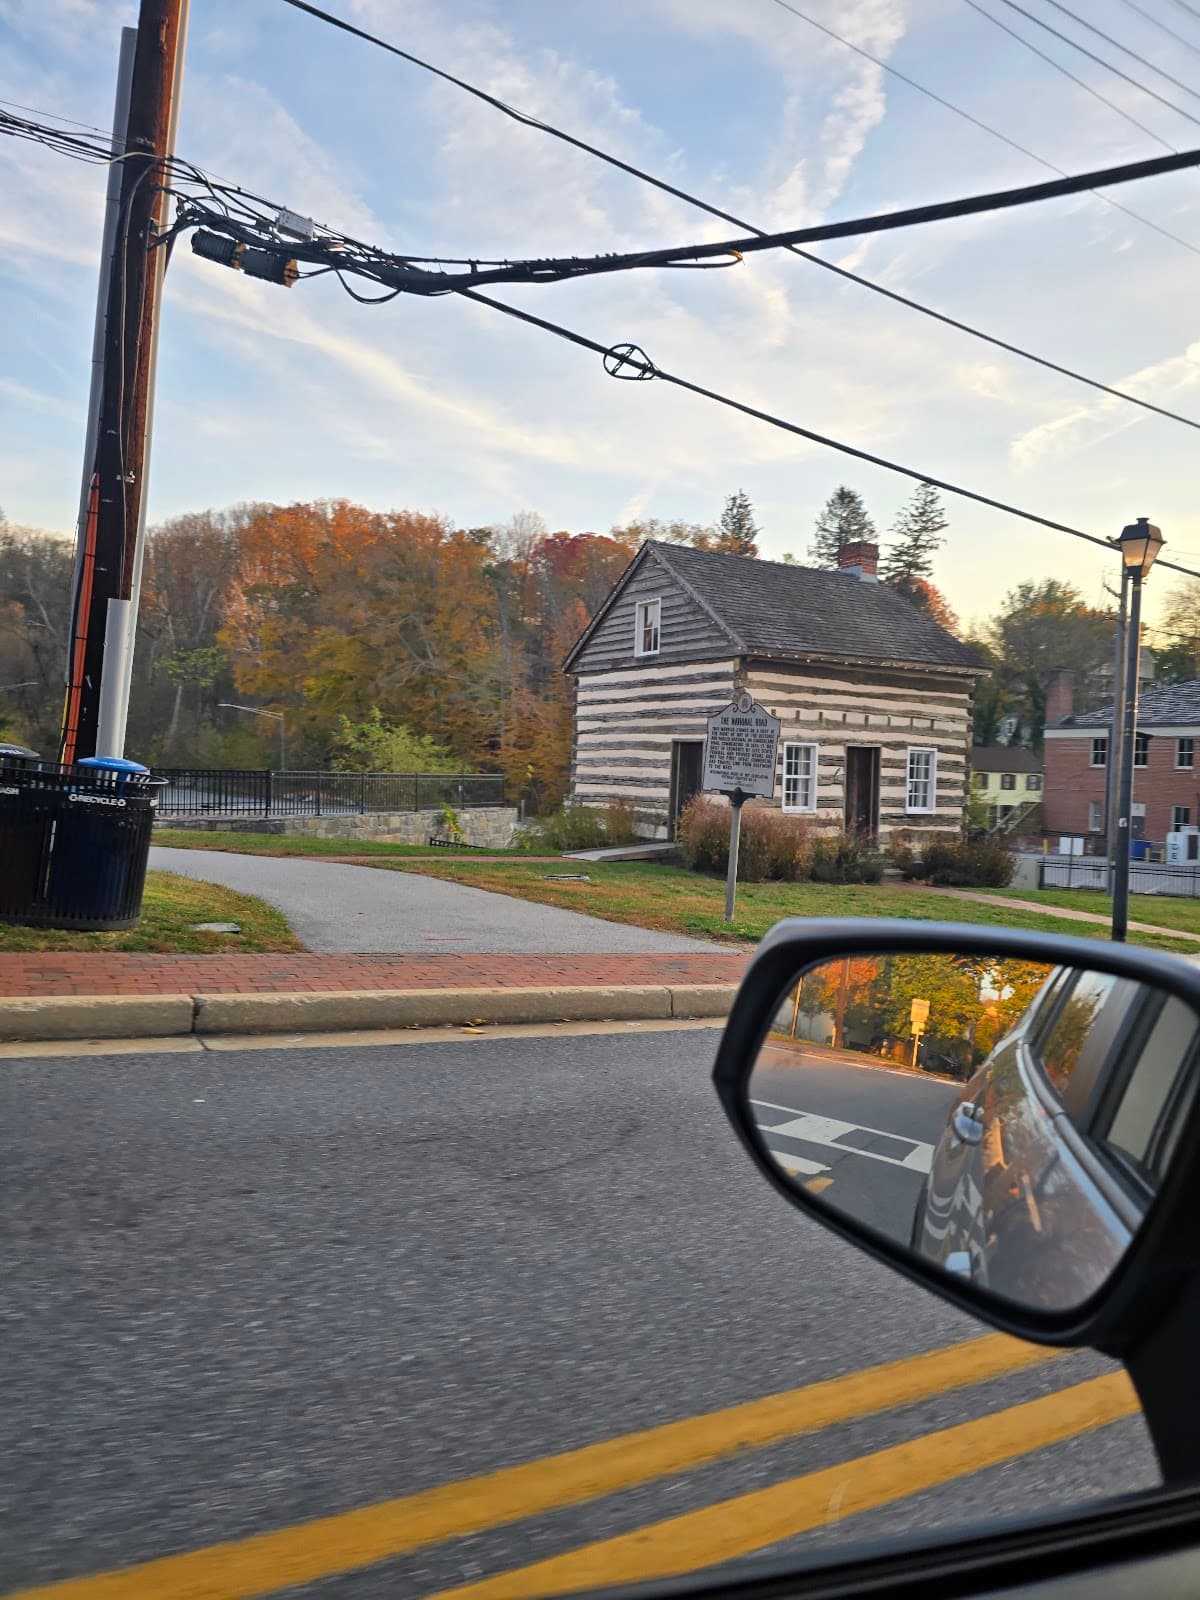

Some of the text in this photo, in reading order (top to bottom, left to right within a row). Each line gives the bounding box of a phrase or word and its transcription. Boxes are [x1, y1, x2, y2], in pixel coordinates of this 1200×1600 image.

[732, 717, 752, 726] NATIONAL
[756, 718, 768, 726] ROAD
[78, 796, 118, 806] RECYCLE
